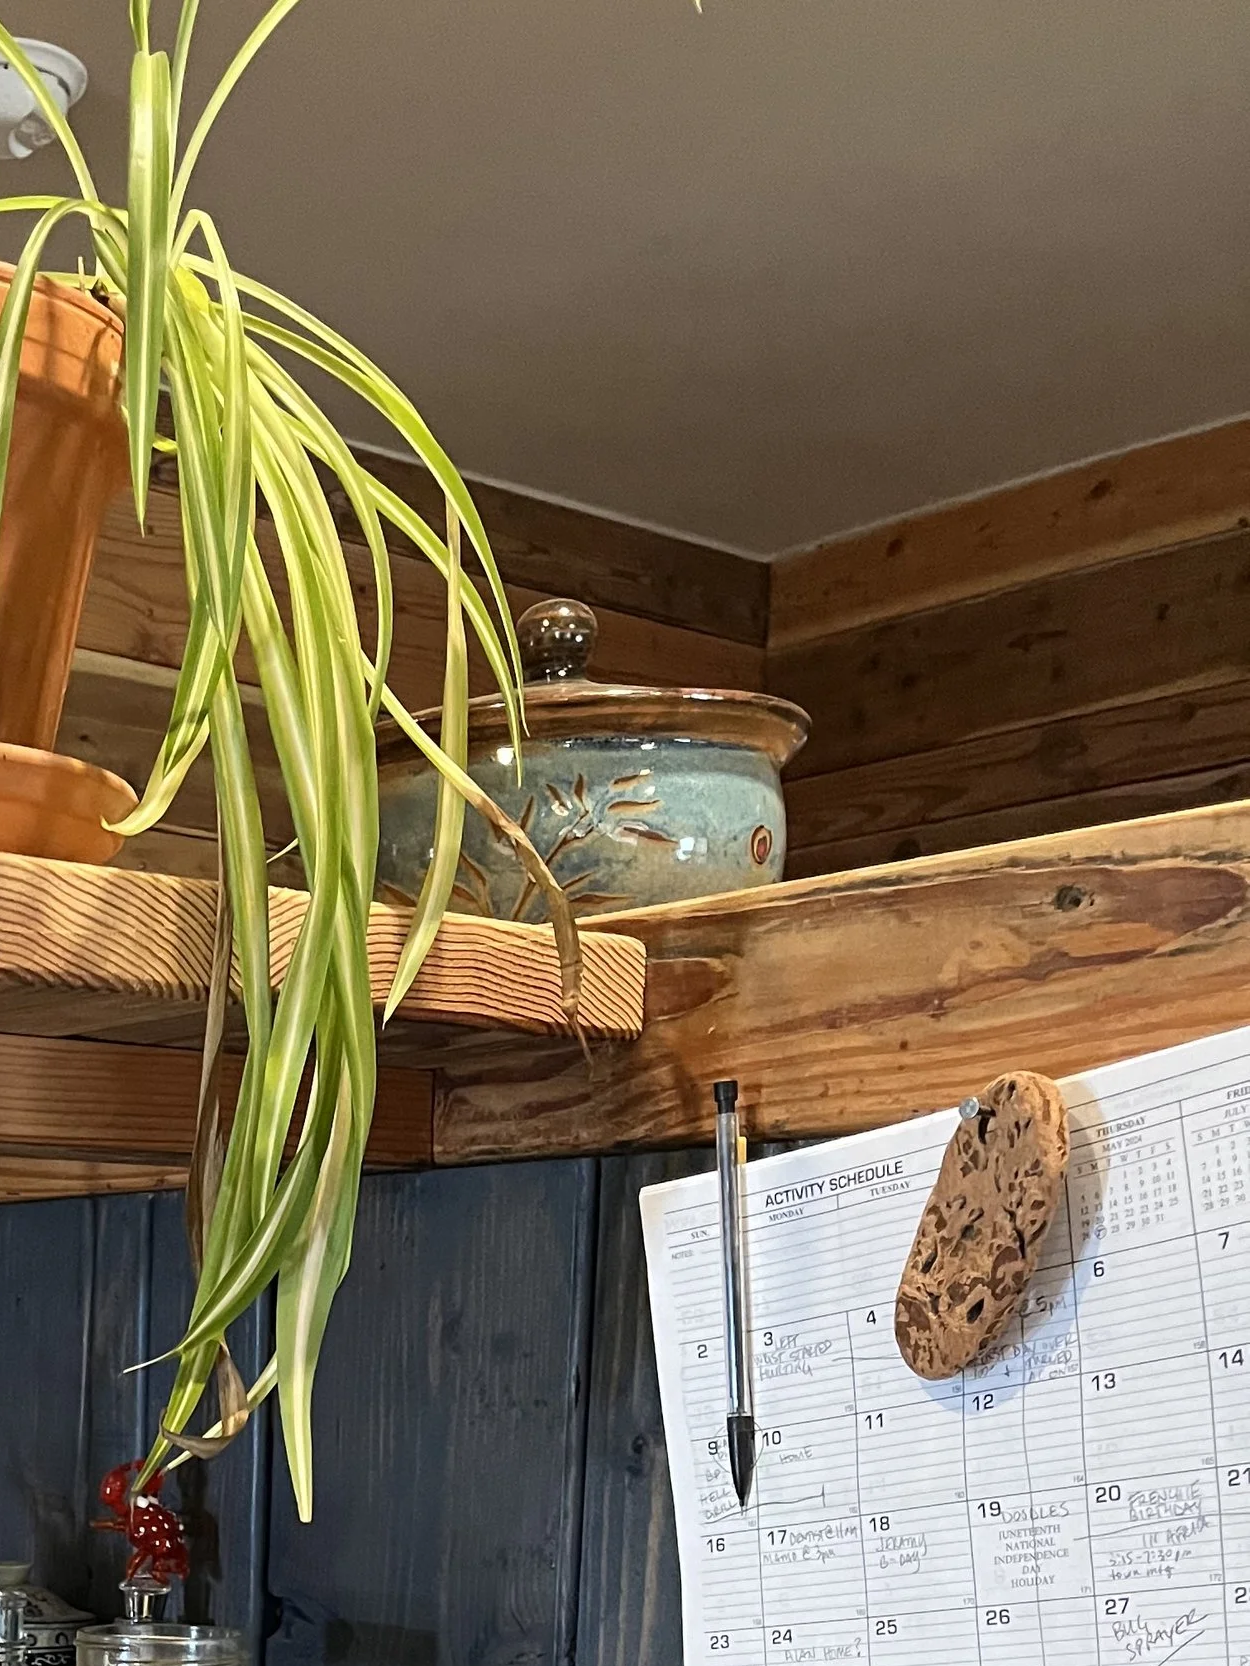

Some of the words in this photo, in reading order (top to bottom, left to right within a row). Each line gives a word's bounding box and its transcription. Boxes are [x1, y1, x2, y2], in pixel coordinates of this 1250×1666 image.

[1224, 1106, 1247, 1119] JULY
[1095, 1116, 1146, 1138] THURSDAY
[1102, 1140, 1122, 1152] MAY
[1124, 1135, 1142, 1147] 2024
[764, 1180, 826, 1208] ACTIVITY
[829, 1160, 904, 1192] SCHEDULE
[870, 1181, 912, 1198] TUESDAY
[768, 1207, 805, 1224] MONDAY
[1217, 1231, 1230, 1250] 7
[1093, 1261, 1105, 1278] 6
[866, 1310, 877, 1325] 4
[763, 1331, 774, 1347] 3
[696, 1344, 709, 1359] 2
[1218, 1349, 1245, 1369] 14
[1091, 1372, 1116, 1392] 13
[972, 1394, 995, 1411] 12
[864, 1413, 885, 1431] 11
[762, 1430, 782, 1447] 10
[708, 1441, 718, 1456] 9
[1095, 1485, 1121, 1504] 20
[977, 1501, 1002, 1519] 19
[869, 1516, 891, 1533] 18
[999, 1524, 1061, 1541] JUNETEENTH
[706, 1538, 726, 1553] 16
[767, 1530, 787, 1546] 17
[1005, 1538, 1056, 1552] NATIONAL
[994, 1548, 1070, 1566] INDEPENDENCE
[1022, 1564, 1043, 1575] DAY
[1011, 1575, 1055, 1589] HOLIDAY
[1234, 1586, 1250, 1604] 2
[1104, 1597, 1130, 1616] 27
[985, 1609, 1011, 1626] 26
[875, 1619, 898, 1636] 25
[710, 1635, 730, 1650] 23
[771, 1629, 793, 1645] 24
